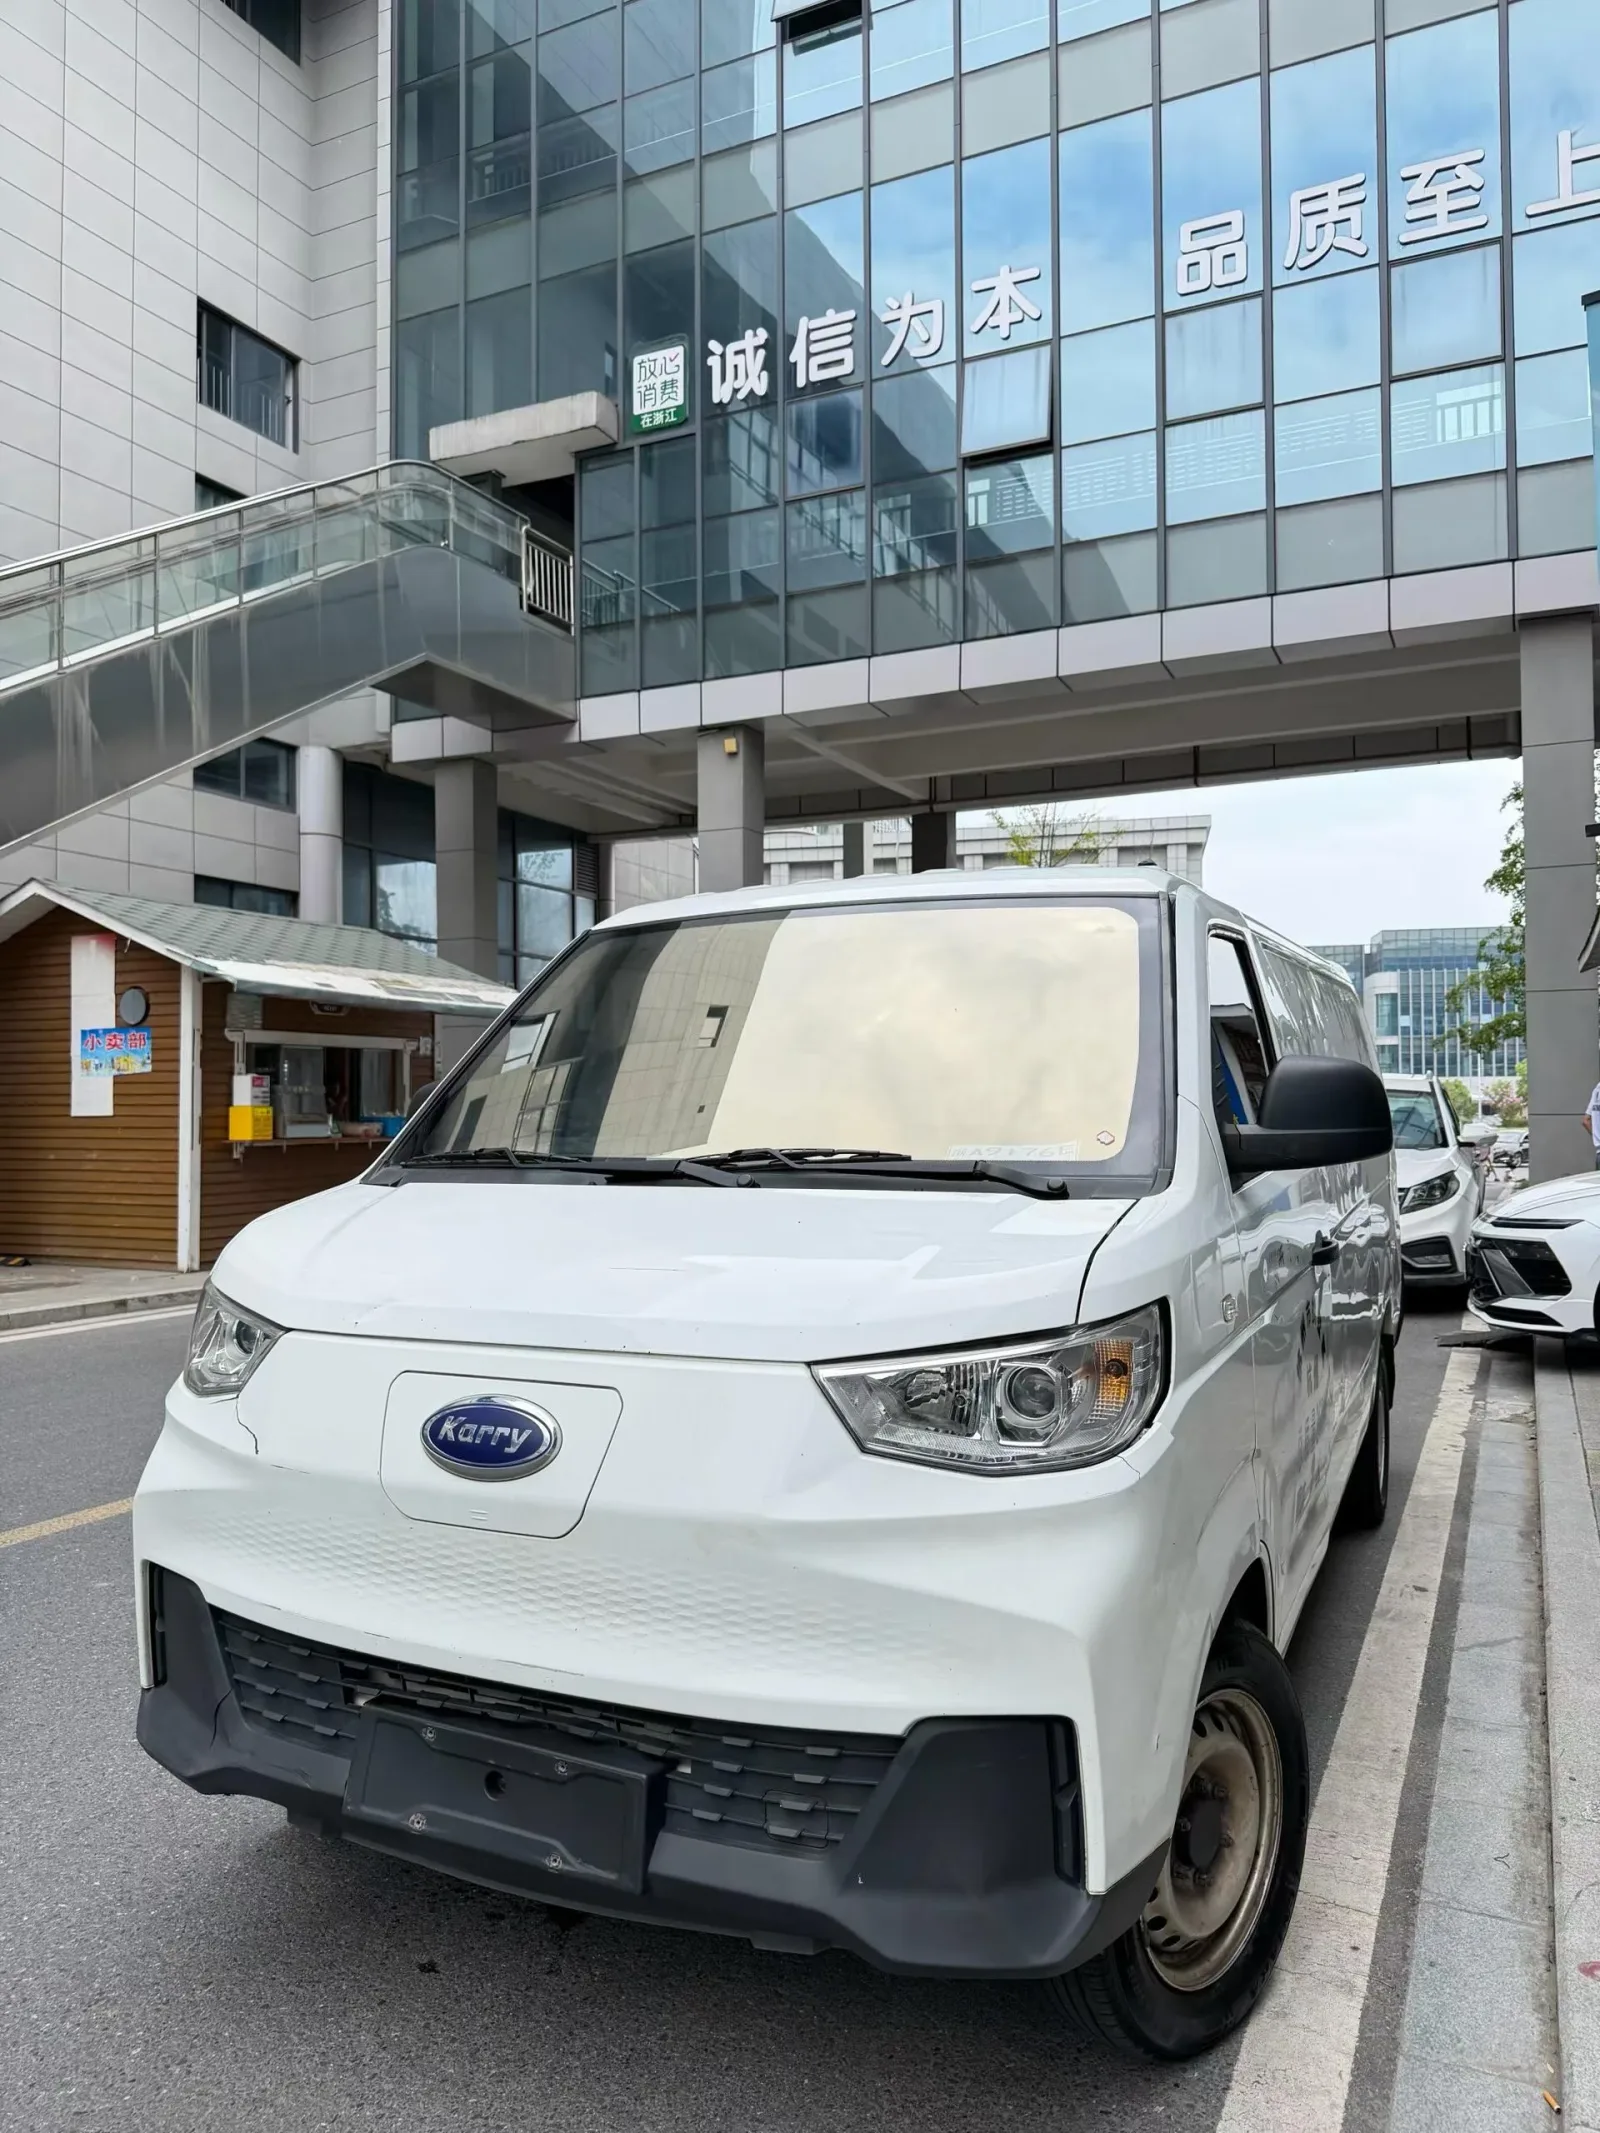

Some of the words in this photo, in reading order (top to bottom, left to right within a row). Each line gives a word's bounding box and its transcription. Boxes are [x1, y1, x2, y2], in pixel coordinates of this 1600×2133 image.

[706, 264, 1043, 404] 诚信为本
[1176, 129, 1600, 296] 品质至上
[637, 352, 680, 383] 放心
[636, 377, 679, 411] 消费
[639, 407, 678, 429] 在浙江
[83, 1031, 148, 1052] 小卖部
[437, 1415, 533, 1454] Karry
